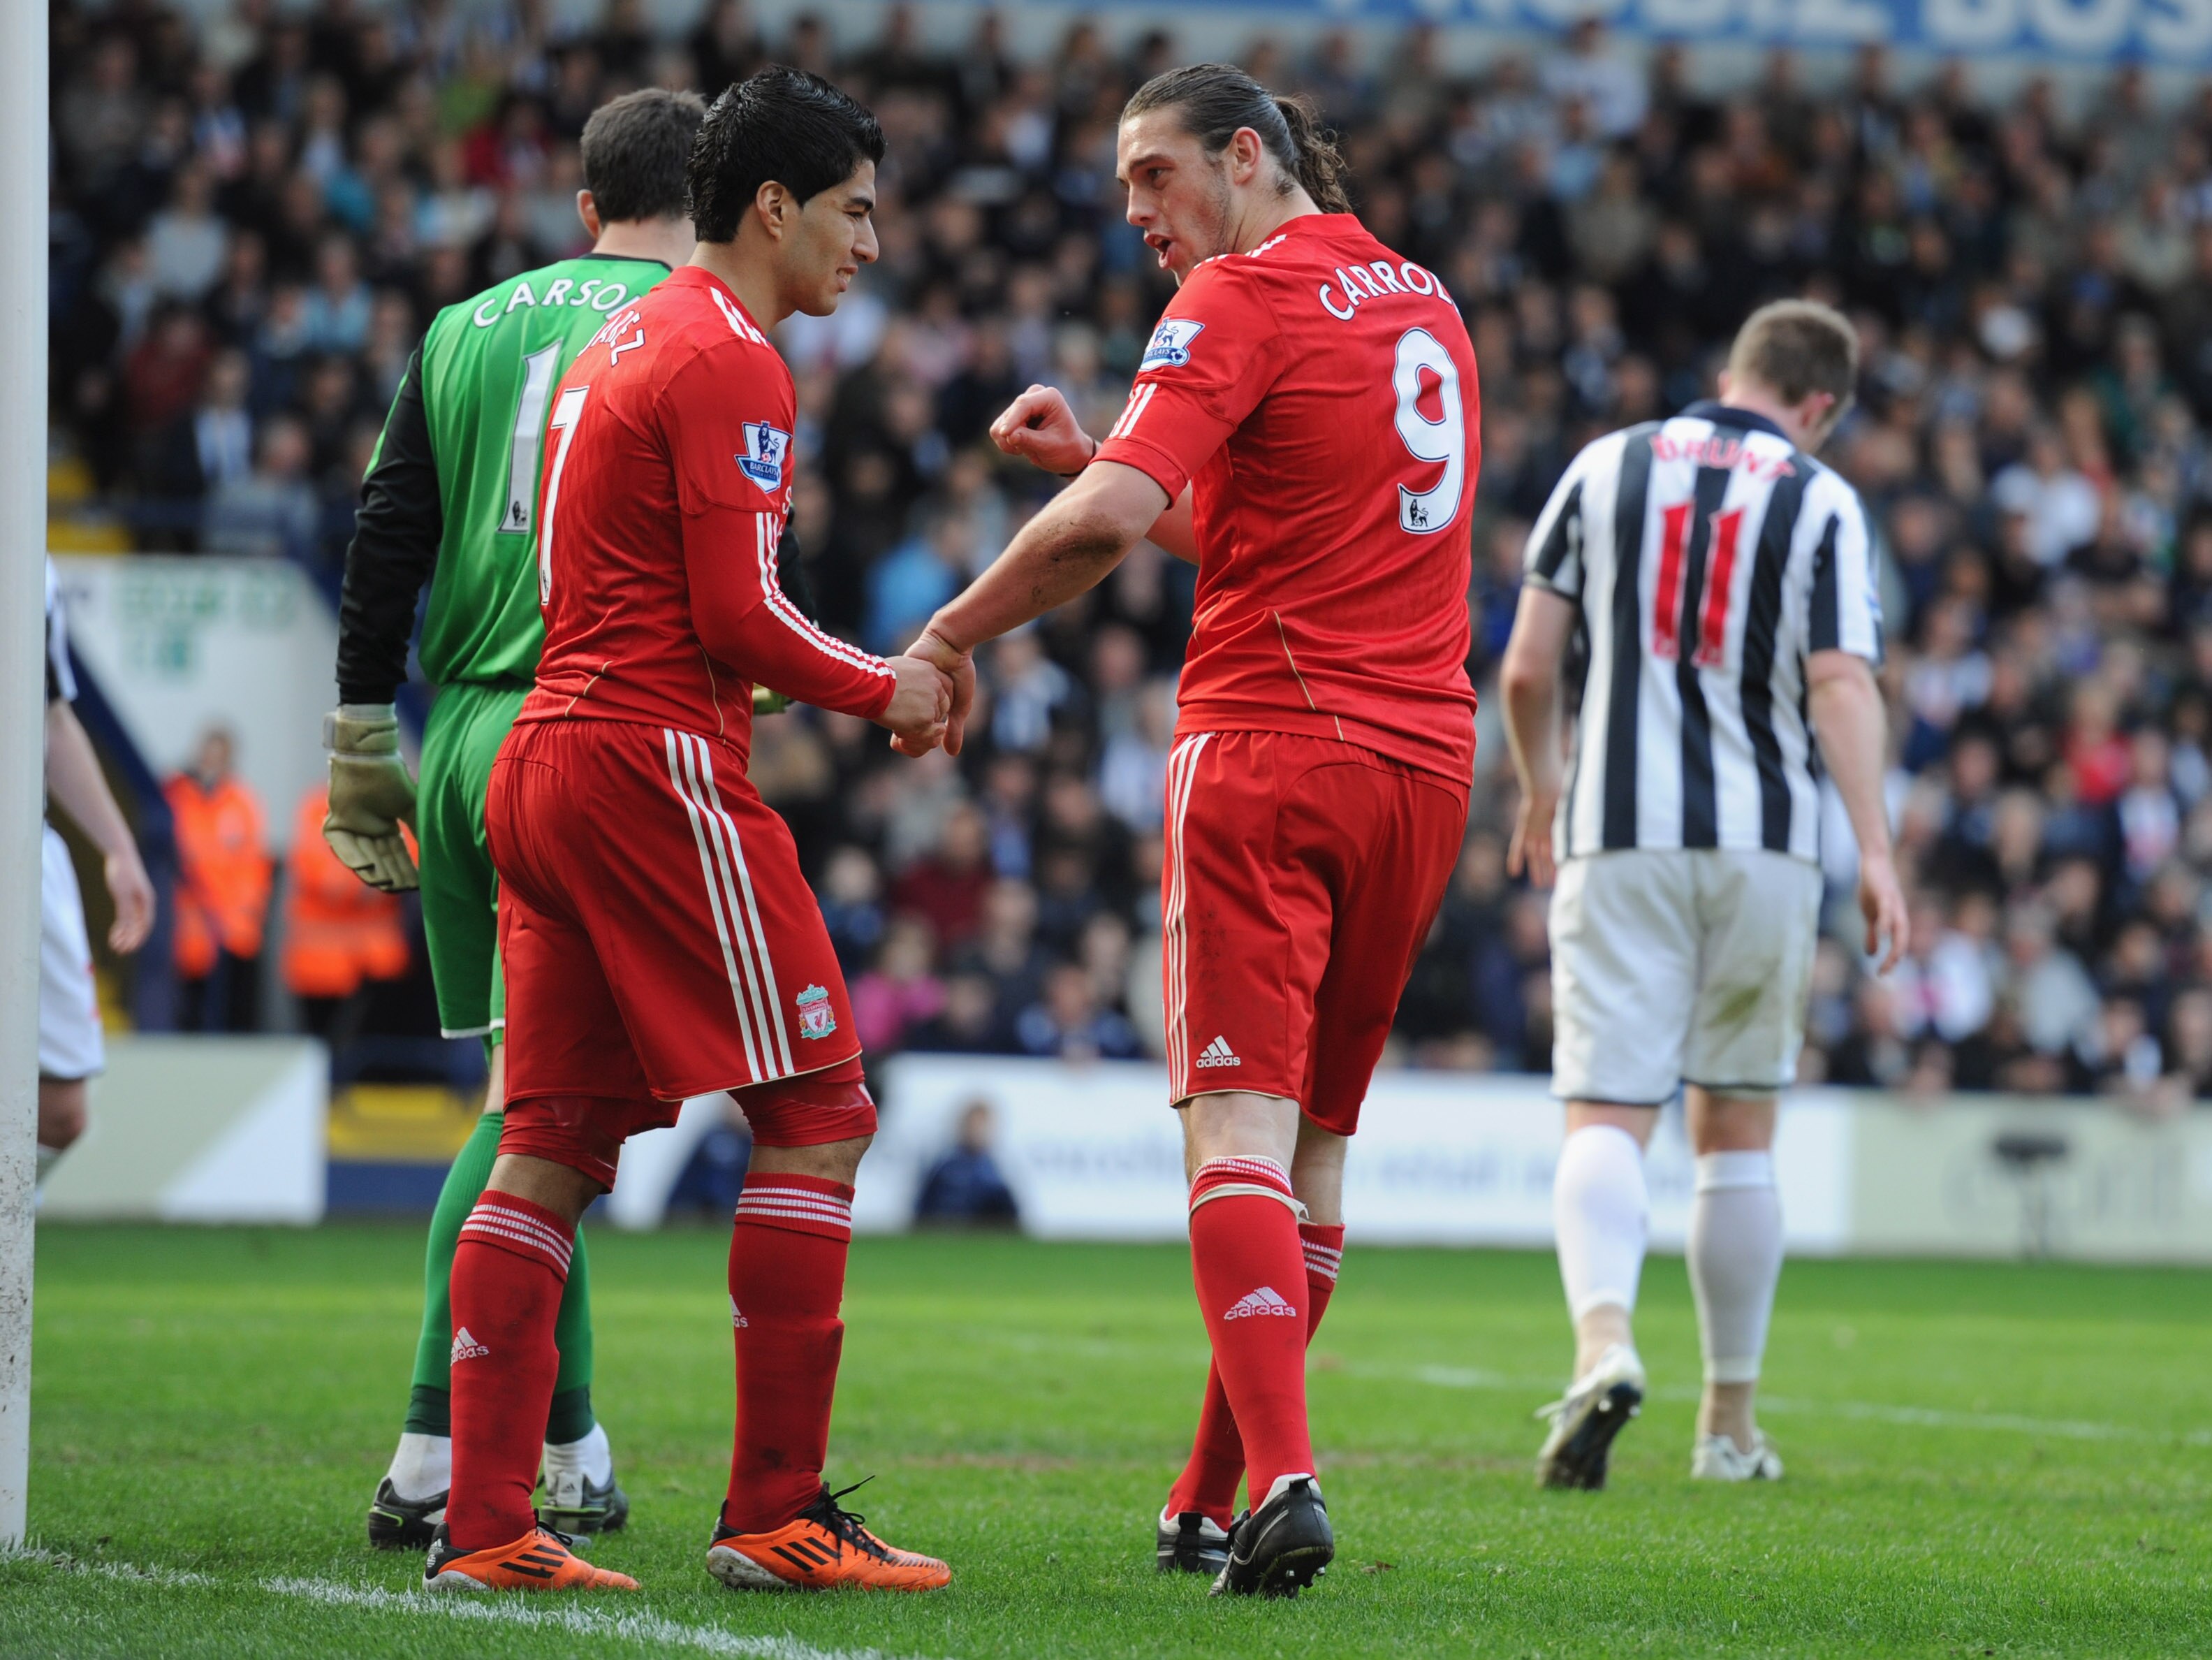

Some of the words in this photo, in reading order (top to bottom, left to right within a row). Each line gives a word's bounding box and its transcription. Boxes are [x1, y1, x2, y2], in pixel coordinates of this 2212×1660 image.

[1319, 260, 1463, 321] CARROL
[497, 338, 563, 533] 1
[538, 385, 589, 606] 7
[1392, 326, 1466, 536] 9
[1651, 500, 1746, 668] 11
[1196, 1054, 1241, 1069] adidas
[1224, 1304, 1297, 1320] adidas
